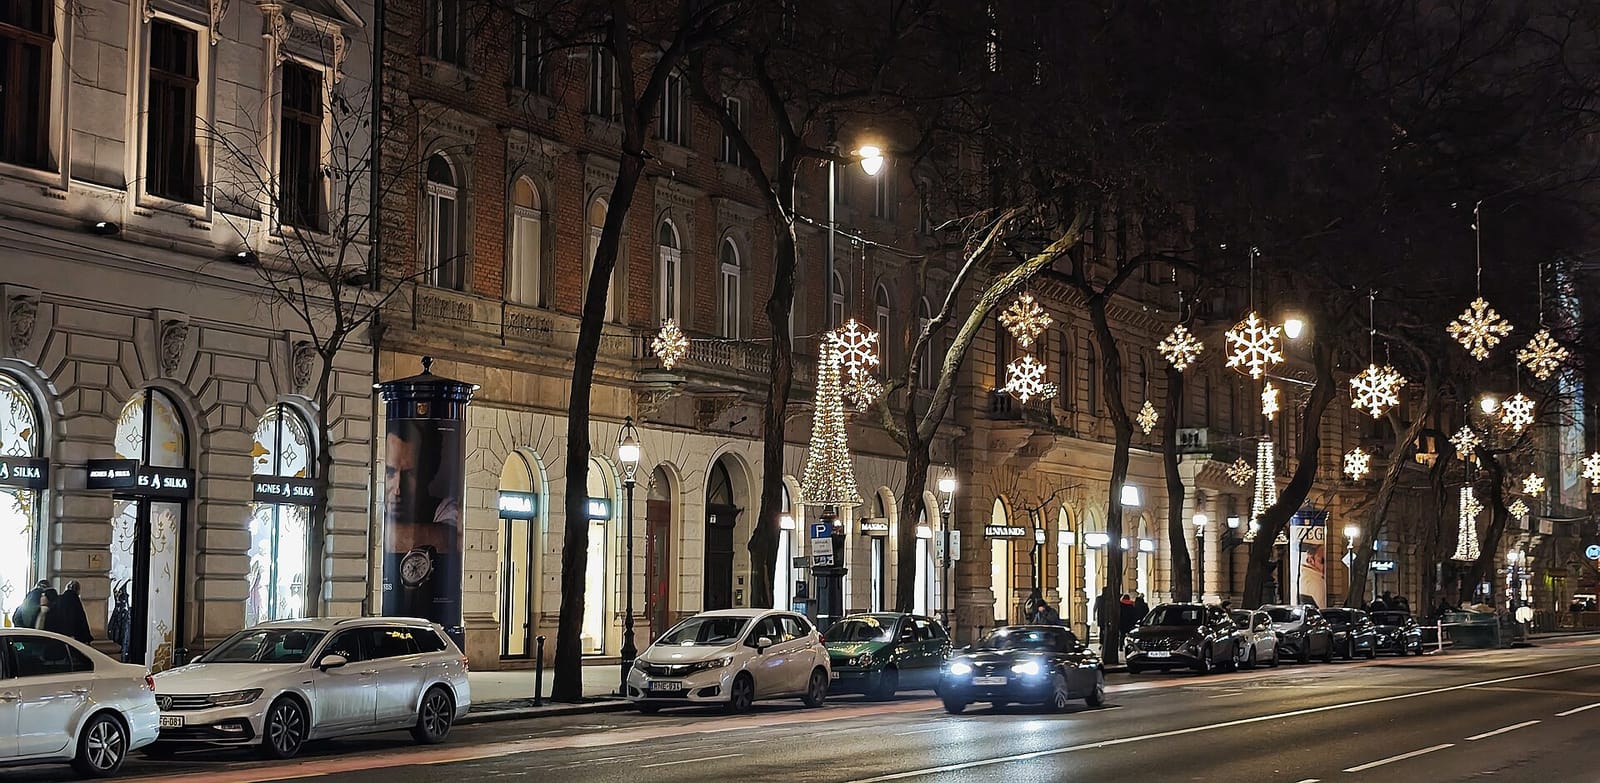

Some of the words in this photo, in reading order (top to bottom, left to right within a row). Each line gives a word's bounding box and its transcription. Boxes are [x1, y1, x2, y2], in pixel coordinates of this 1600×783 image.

[13, 466, 41, 478] SILKA
[138, 475, 149, 486] ES
[163, 478, 188, 488] SILKA
[256, 483, 281, 494] AGNES
[292, 486, 314, 497] SILKA
[815, 525, 826, 538] P
